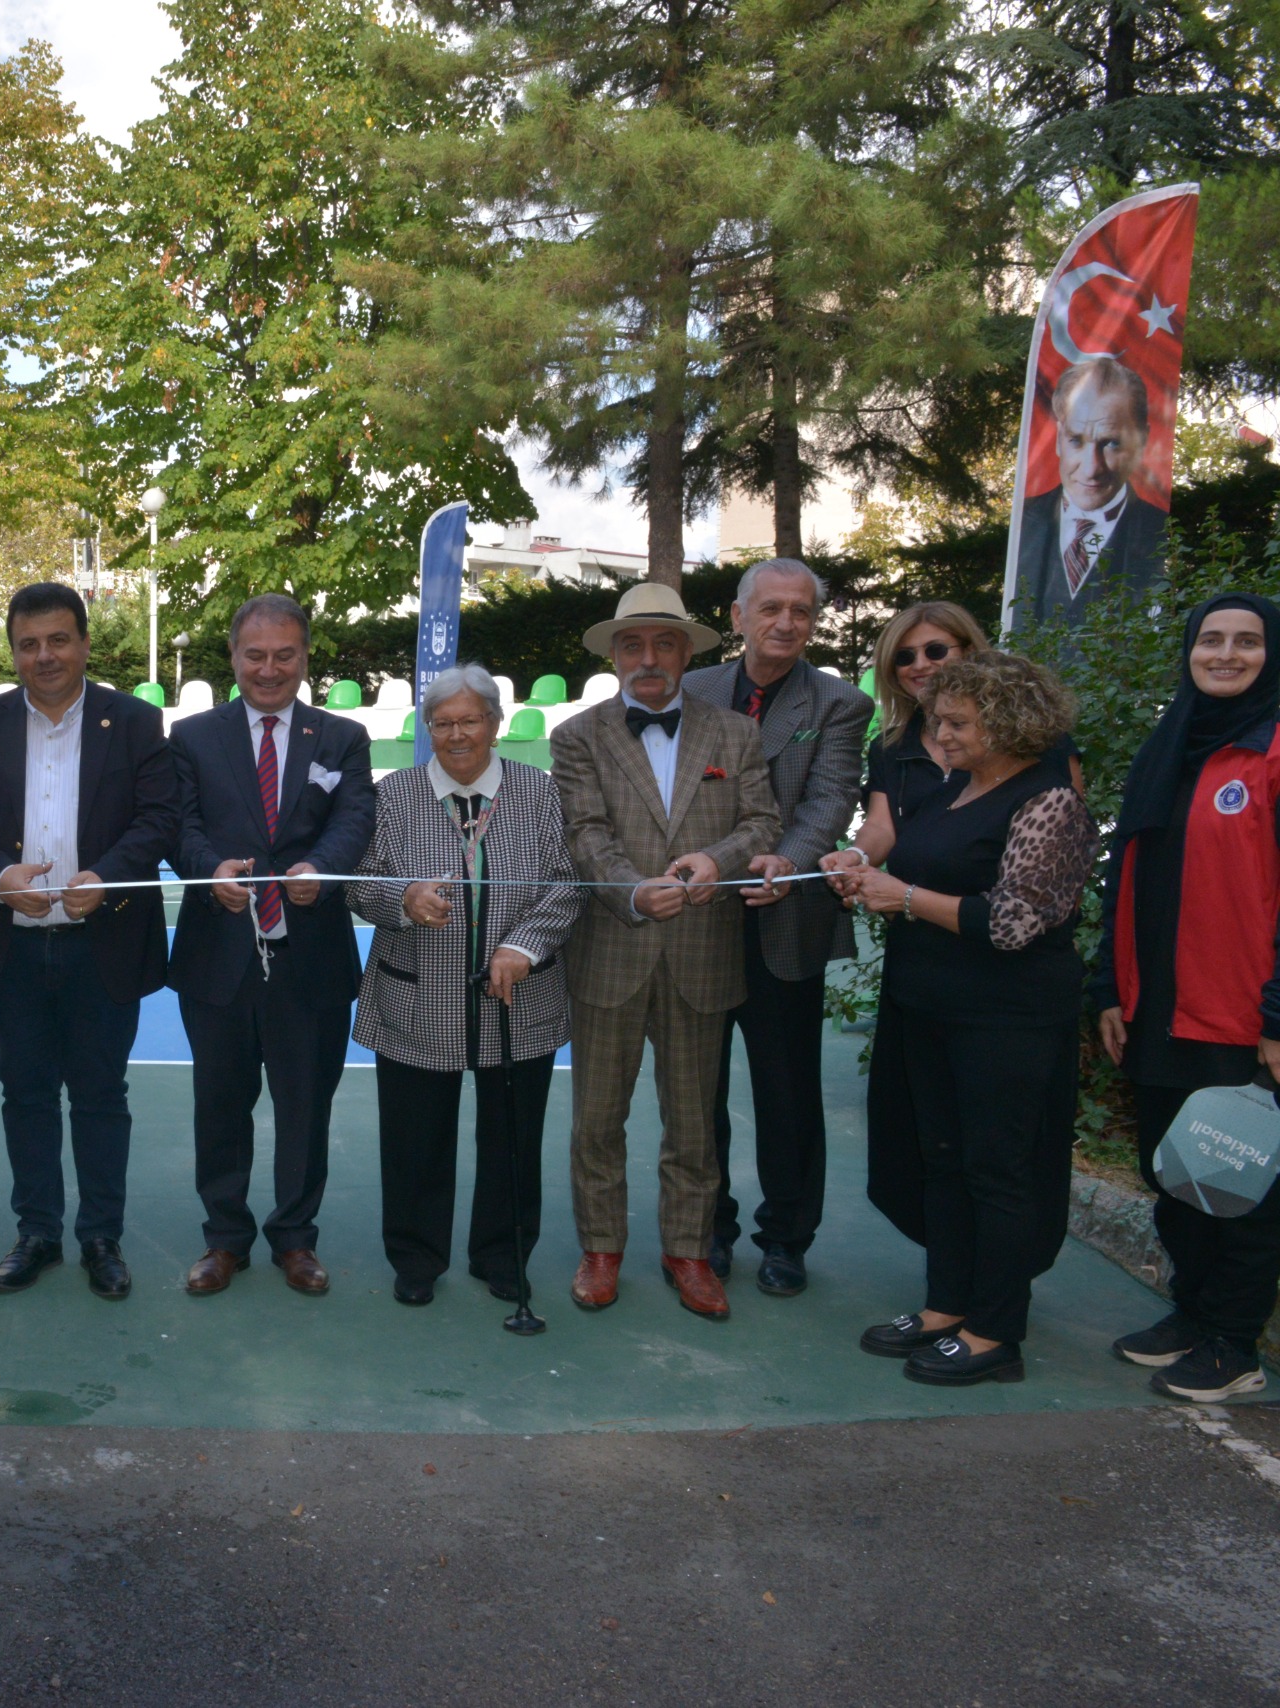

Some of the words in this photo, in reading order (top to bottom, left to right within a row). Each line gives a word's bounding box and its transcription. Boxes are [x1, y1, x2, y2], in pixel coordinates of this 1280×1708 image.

[1189, 1120, 1270, 1167] Pickleball
[1198, 1142, 1211, 1156] To
[1215, 1150, 1245, 1171] Born
